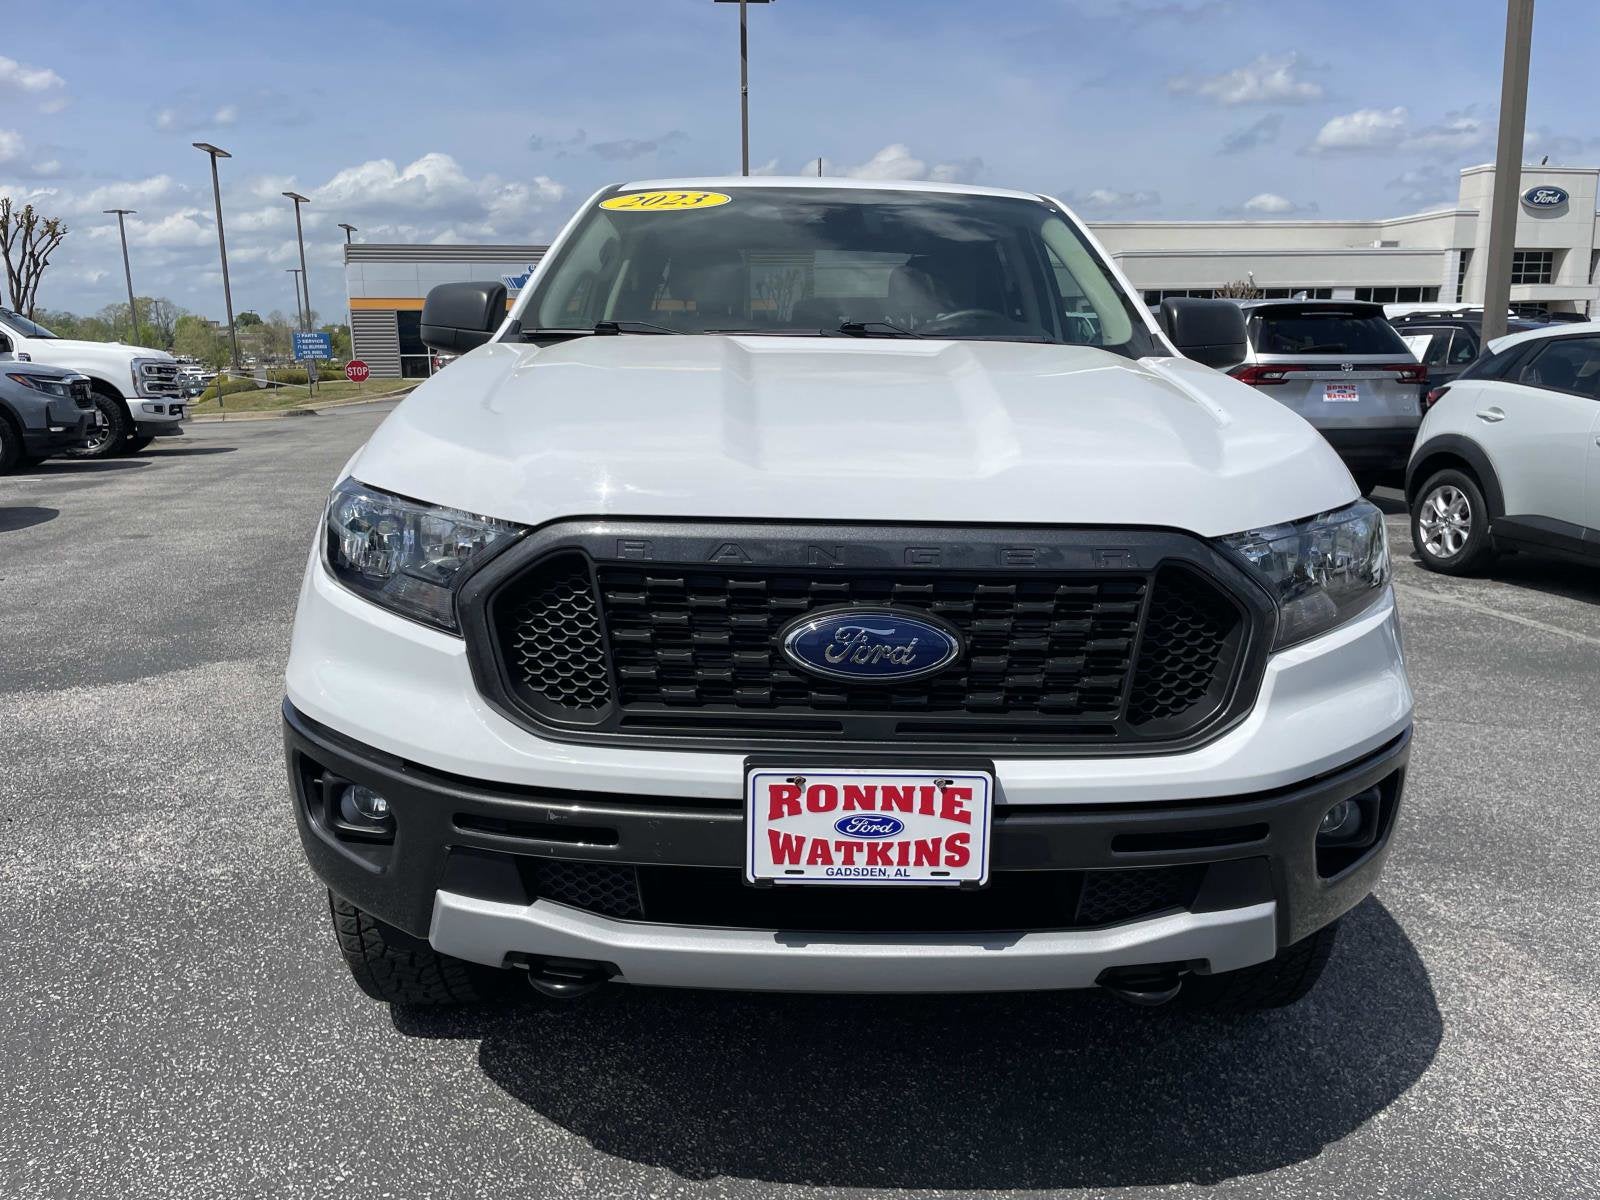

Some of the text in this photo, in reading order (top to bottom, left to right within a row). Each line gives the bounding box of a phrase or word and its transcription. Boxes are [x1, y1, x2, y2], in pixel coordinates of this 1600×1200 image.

[618, 194, 710, 208] 2023
[1533, 190, 1561, 203] Ford
[347, 367, 368, 376] STOP
[616, 539, 1140, 568] RANGER
[825, 626, 919, 665] Ford
[768, 784, 973, 825] RONNIE
[846, 817, 894, 834] Ford
[767, 829, 971, 868] WATKINS
[825, 867, 911, 878] GADSDEN, AL
